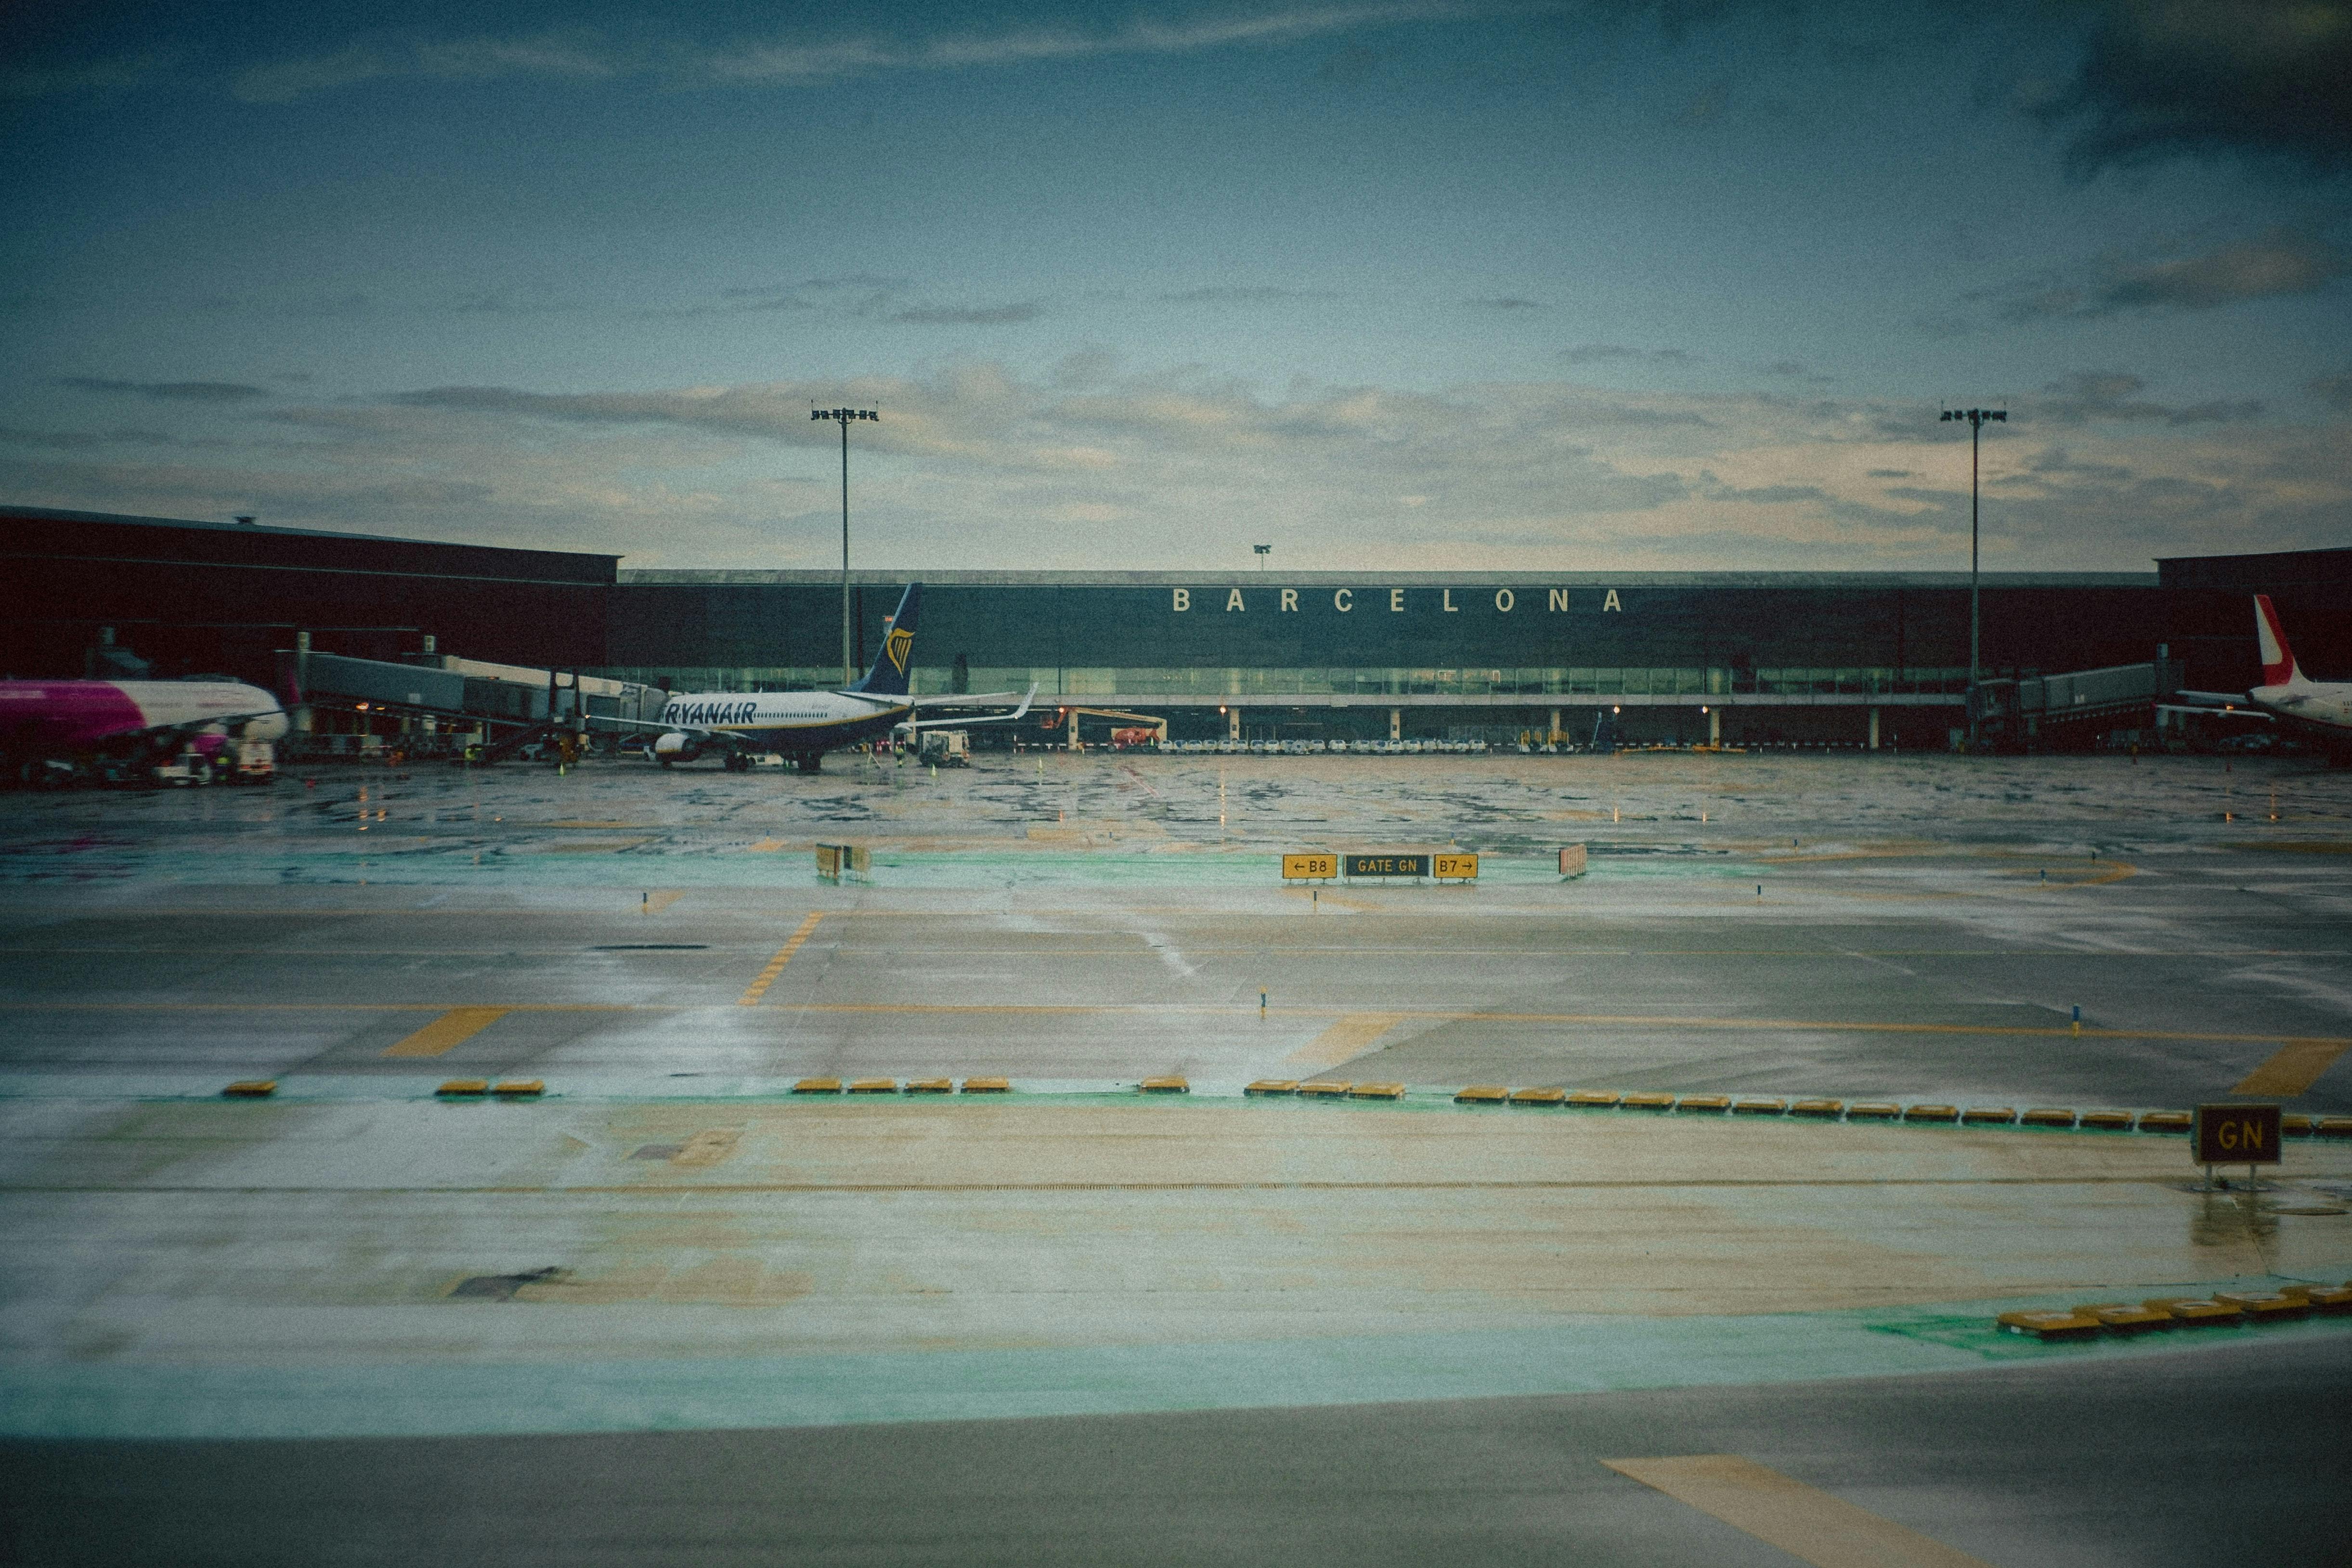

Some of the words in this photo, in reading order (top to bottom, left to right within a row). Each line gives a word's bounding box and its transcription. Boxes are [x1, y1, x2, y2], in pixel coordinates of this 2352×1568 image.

[1173, 588, 1622, 612] BARCELONA
[665, 702, 757, 724] RYANAIR
[1310, 861, 1326, 872] B8
[1358, 860, 1392, 872] GATE
[1399, 860, 1416, 872] GN
[1440, 860, 1457, 872] B7
[2219, 1121, 2262, 1149] GN
